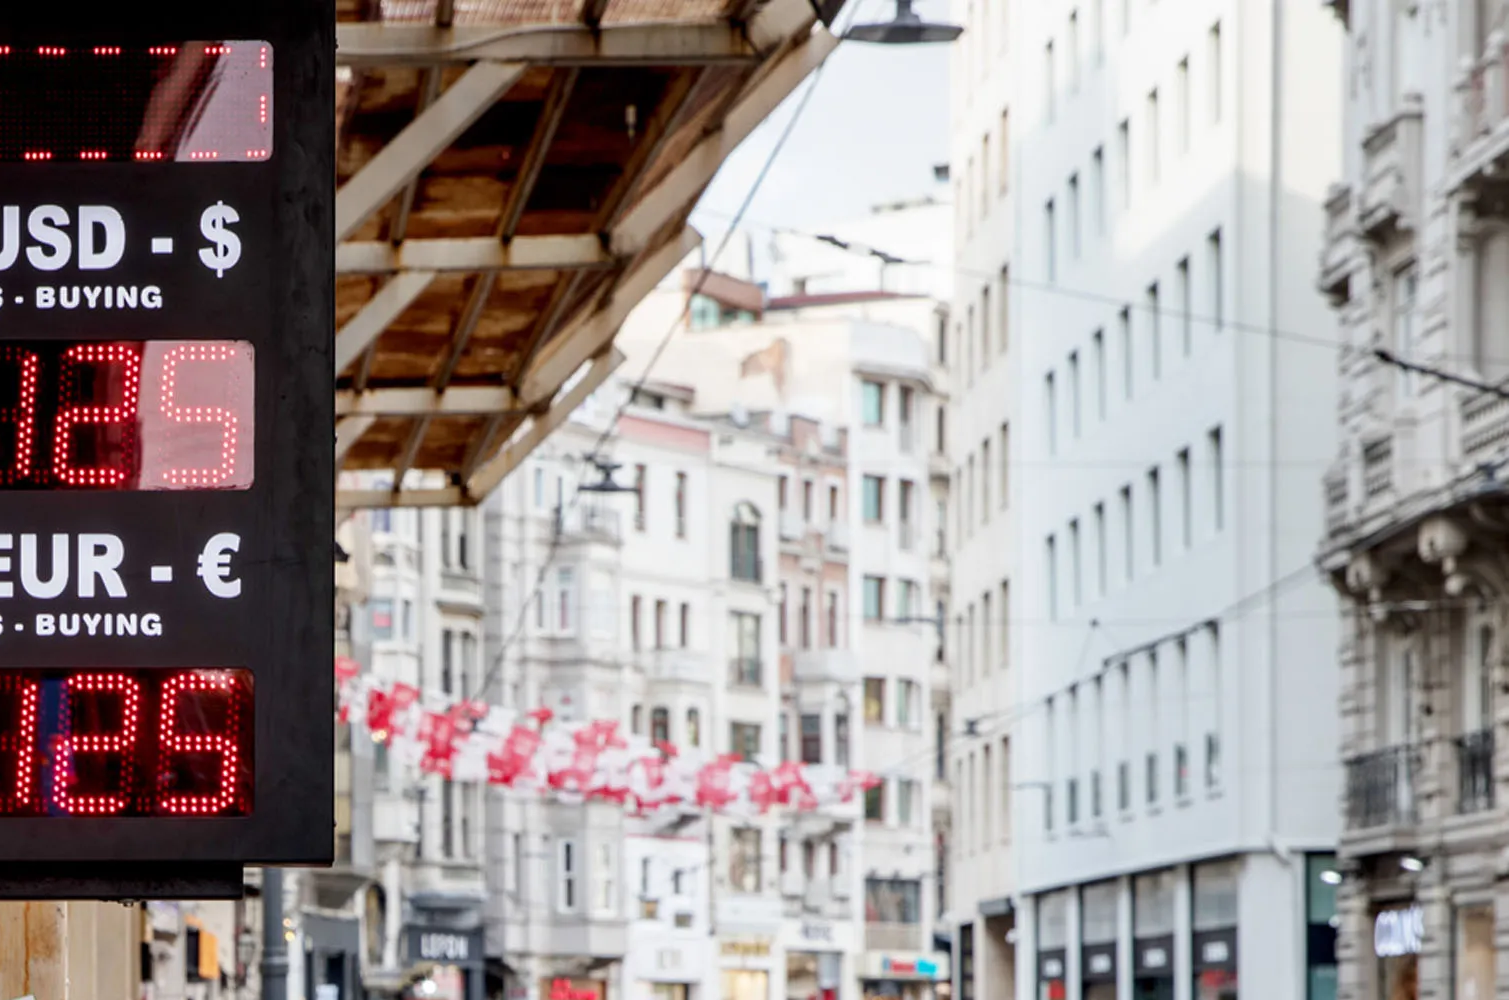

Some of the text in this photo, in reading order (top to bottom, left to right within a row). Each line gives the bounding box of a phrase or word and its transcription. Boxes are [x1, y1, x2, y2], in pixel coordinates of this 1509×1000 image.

[198, 201, 242, 278] $
[35, 286, 163, 308] BUYING
[197, 533, 242, 598] €
[35, 613, 163, 636] BUYING
